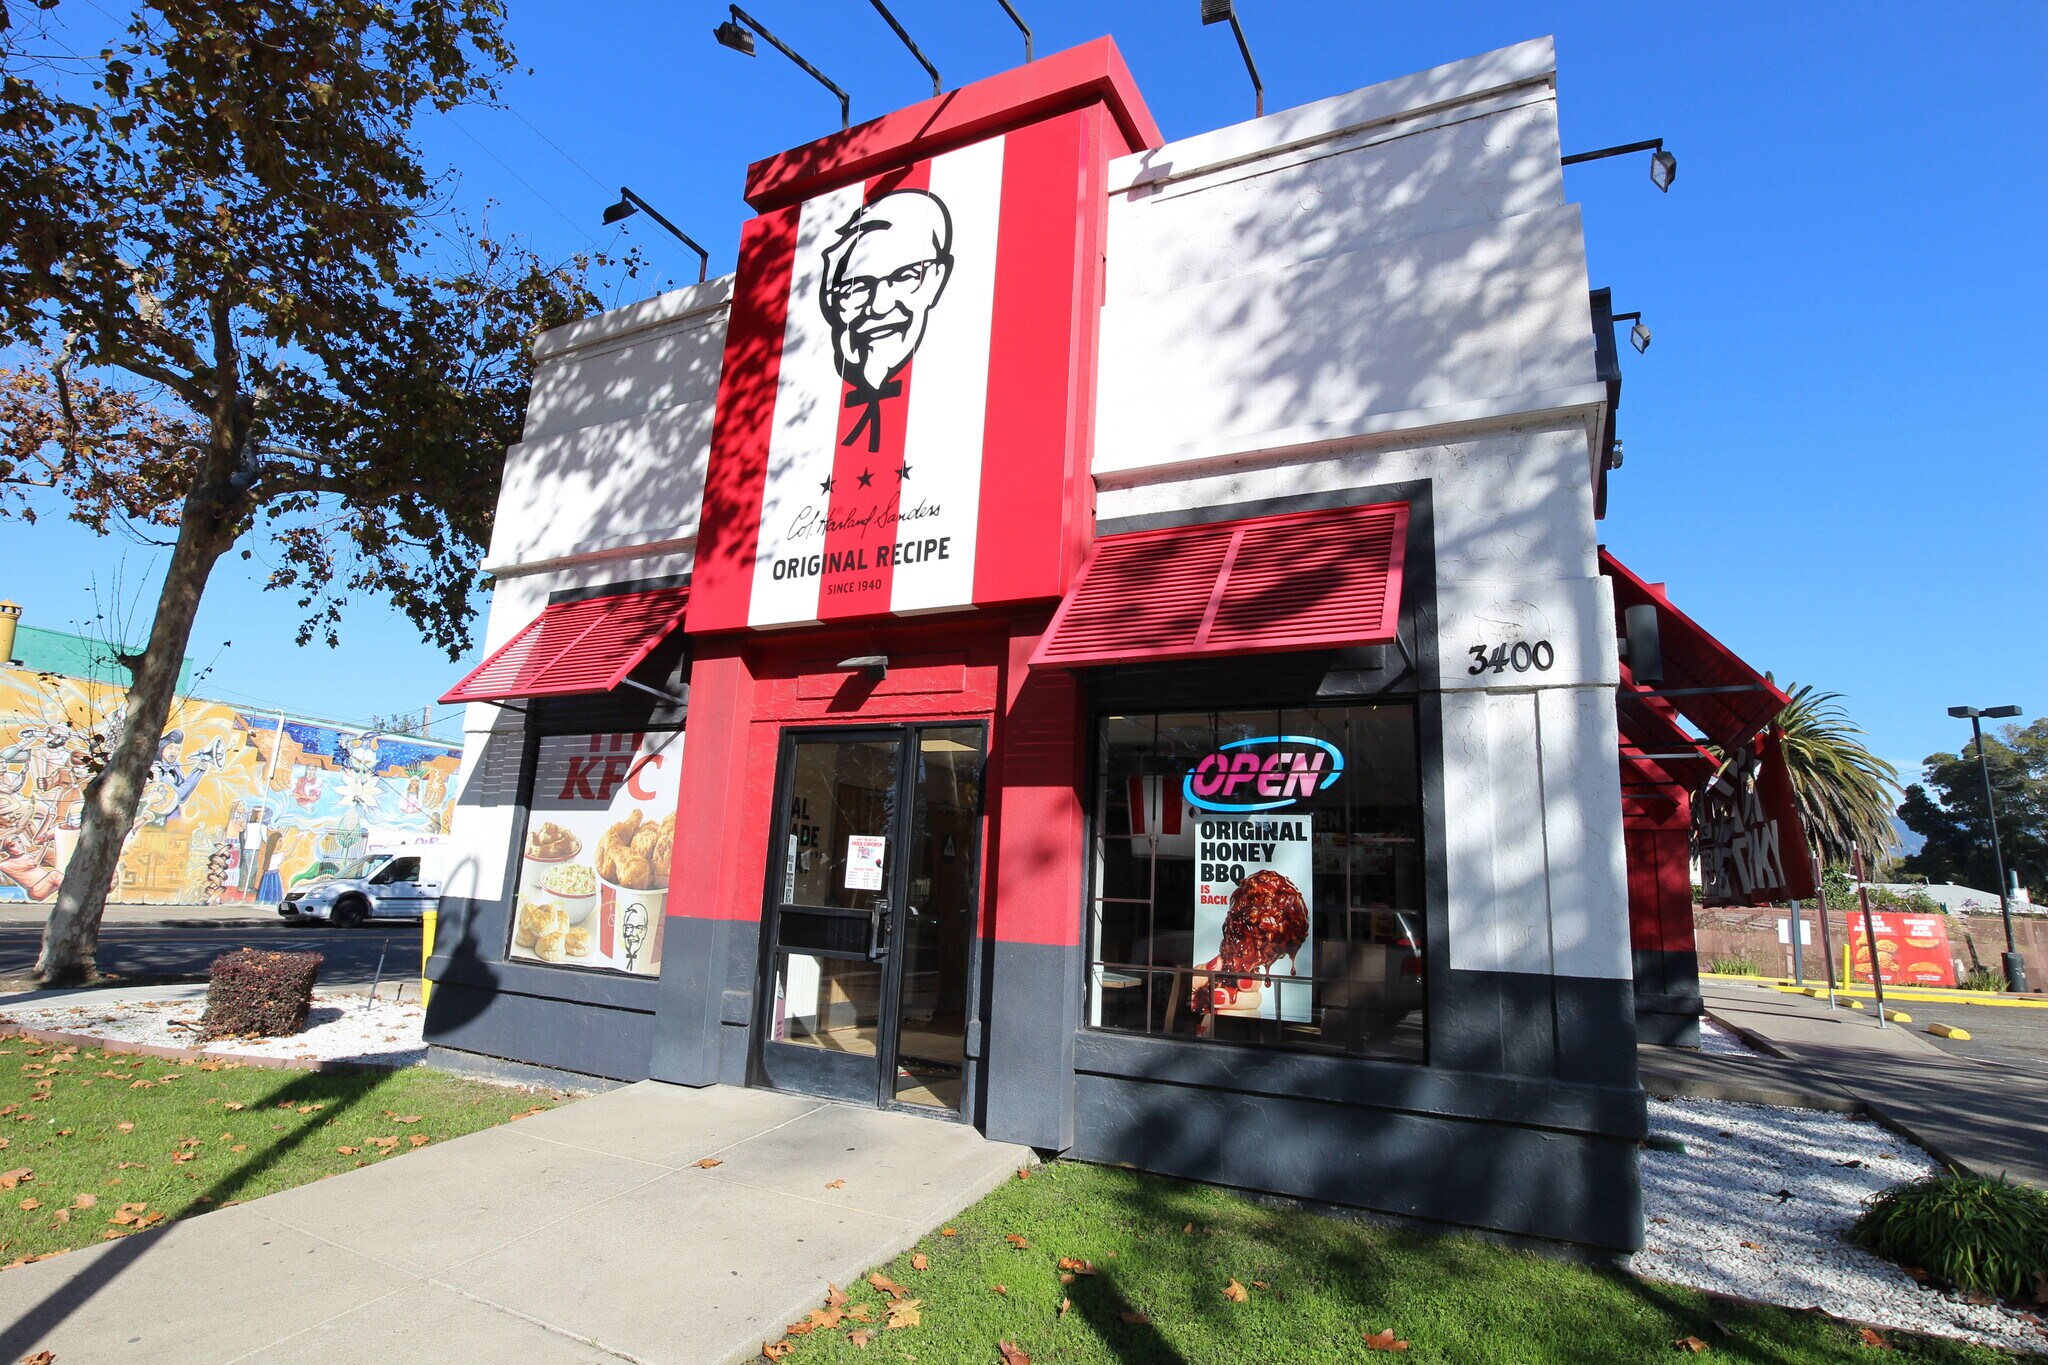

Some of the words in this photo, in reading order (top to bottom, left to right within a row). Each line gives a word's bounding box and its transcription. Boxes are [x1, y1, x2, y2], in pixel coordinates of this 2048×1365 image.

[816, 505, 877, 540] Harland
[874, 491, 941, 528] Sanders
[772, 548, 868, 581] ORIGINAL
[876, 536, 951, 568] RECIPE
[827, 582, 854, 595] SINCE
[857, 579, 882, 592] 1940
[1468, 640, 1555, 676] 3400
[558, 754, 664, 801] KFC
[1193, 753, 1326, 797] OPEN
[1200, 820, 1308, 841] ORIGINAL
[1200, 842, 1276, 862] HONEY
[1200, 863, 1245, 886] BBQ
[1200, 885, 1211, 894] IS
[1200, 895, 1228, 905] BACK
